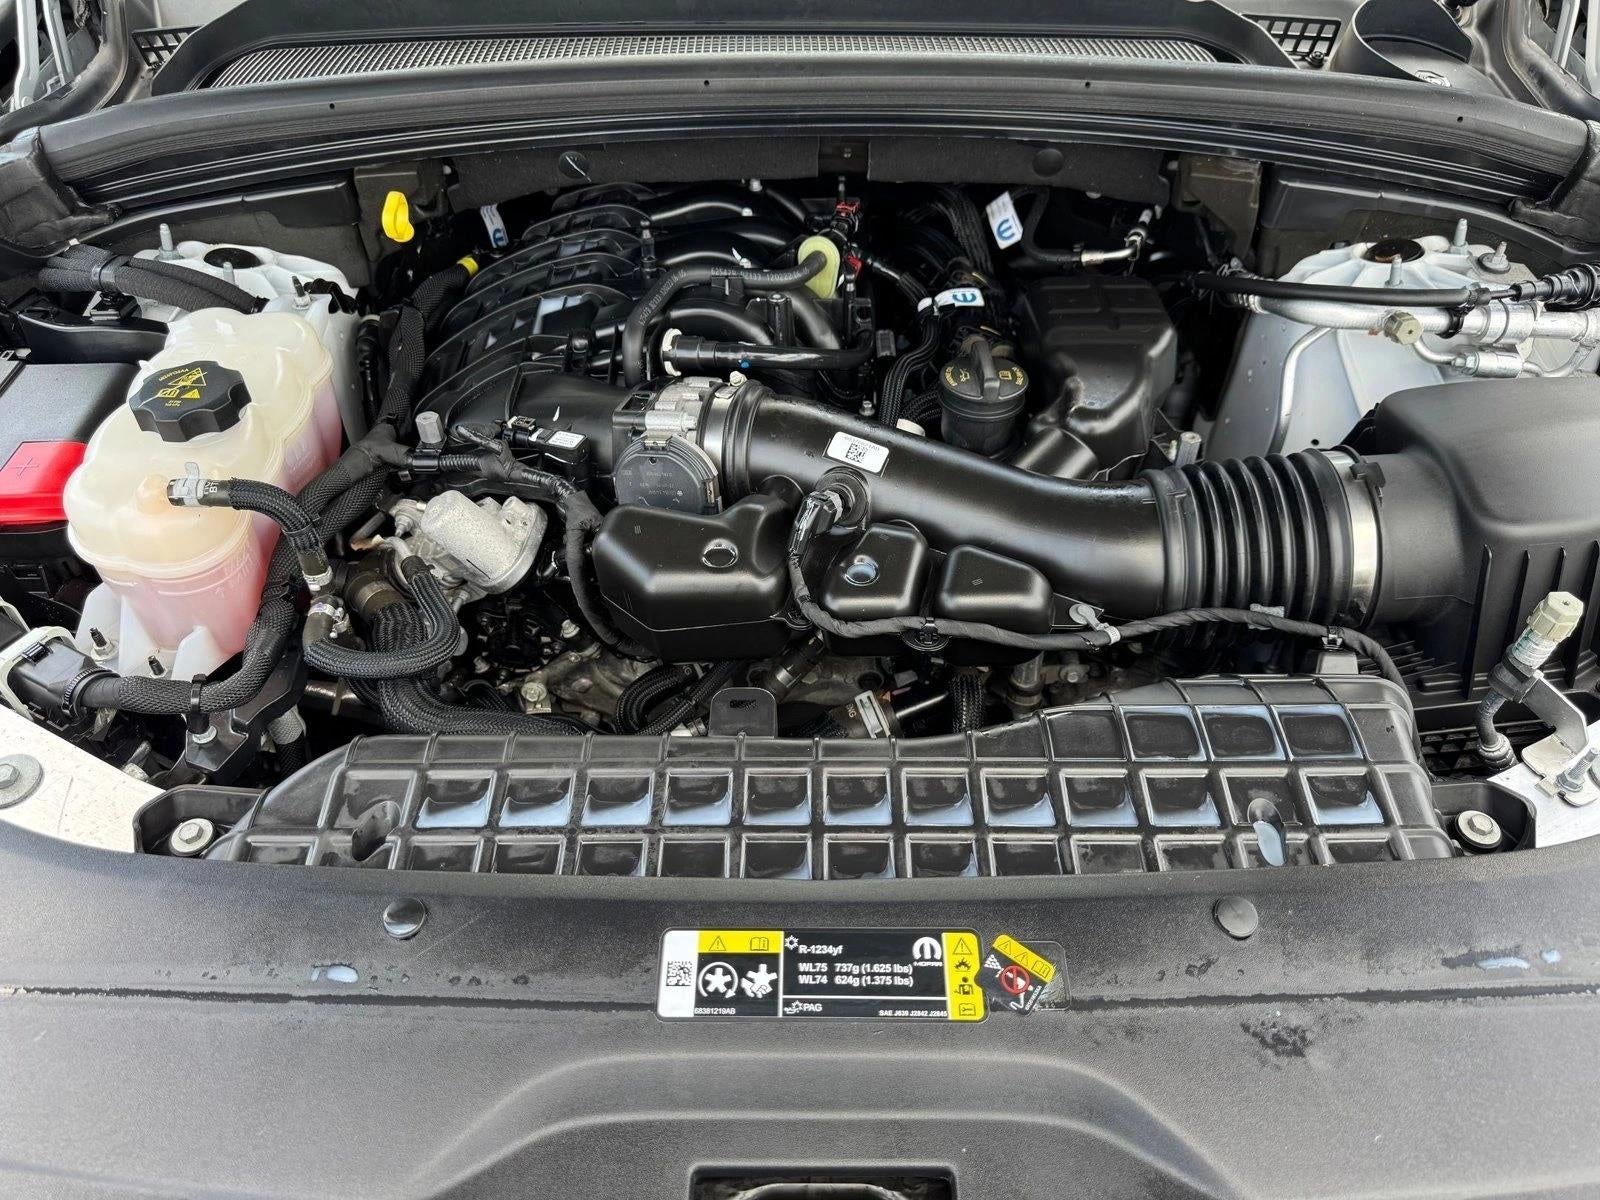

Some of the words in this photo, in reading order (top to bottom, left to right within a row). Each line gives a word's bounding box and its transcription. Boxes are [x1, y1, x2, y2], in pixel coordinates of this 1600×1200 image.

[798, 945, 844, 956] R-1234yf
[798, 962, 828, 972] WL75
[834, 963, 860, 974] 737g
[861, 964, 892, 974] (1.625
[893, 964, 913, 975] lbs)
[798, 975, 828, 985] WL74
[834, 975, 860, 987] 624g
[861, 976, 892, 986] (1.375
[893, 976, 914, 987] lbs)
[803, 1003, 823, 1012] PAG
